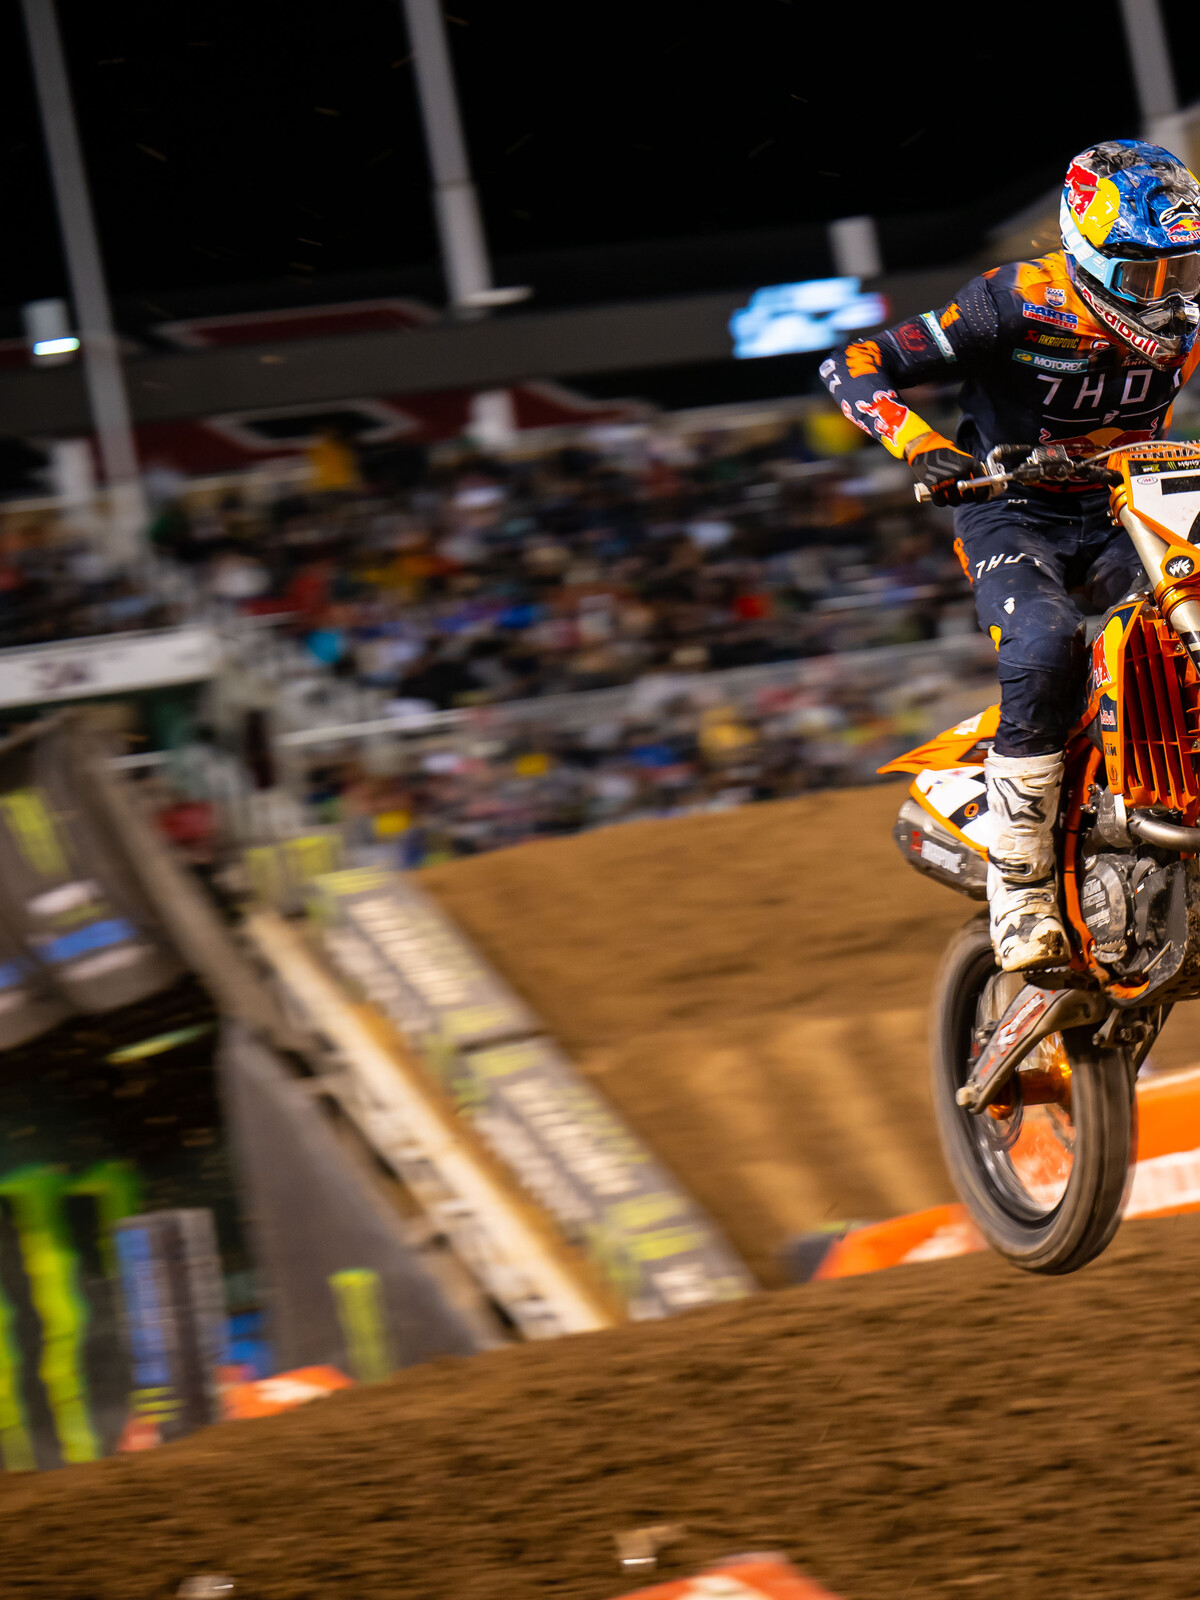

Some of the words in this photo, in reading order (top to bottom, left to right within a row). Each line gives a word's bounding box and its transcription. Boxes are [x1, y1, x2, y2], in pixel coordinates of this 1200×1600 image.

[1169, 231, 1195, 243] Red
[1024, 302, 1079, 325] PARTS
[1081, 287, 1120, 329] Red
[1023, 310, 1078, 330] UNLIMITED
[1033, 355, 1084, 372] MOTOREX
[1037, 367, 1182, 410] THO
